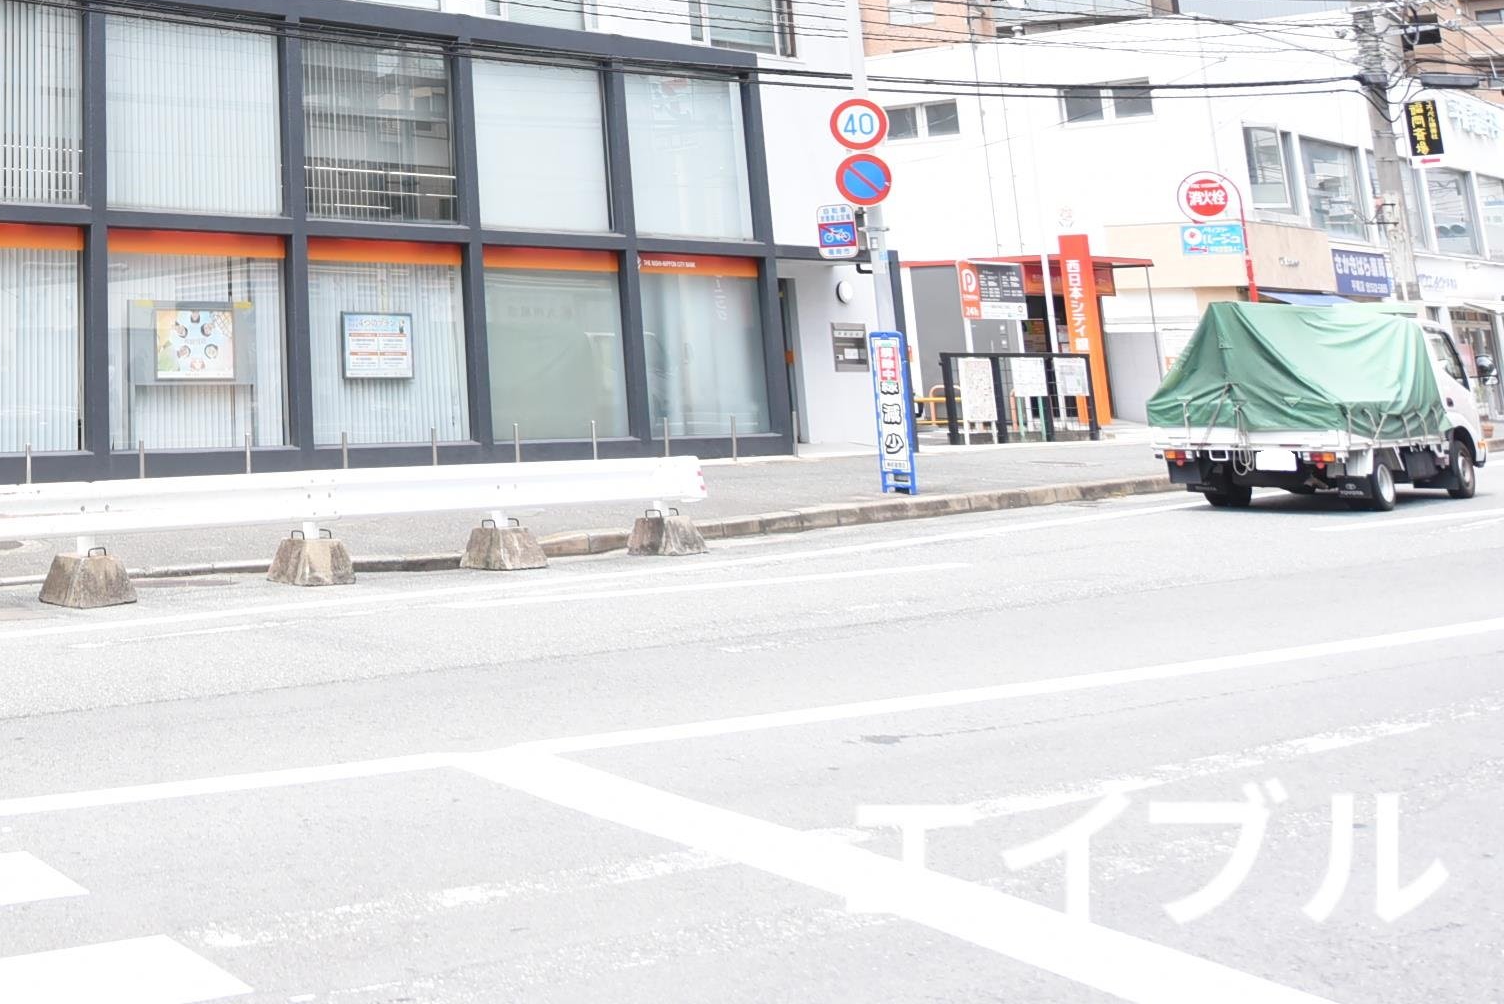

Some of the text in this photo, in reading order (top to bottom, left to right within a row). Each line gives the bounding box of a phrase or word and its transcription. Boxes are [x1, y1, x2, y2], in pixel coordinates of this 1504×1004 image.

[843, 112, 874, 136] 40
[1189, 189, 1226, 206] 消火栓
[1065, 259, 1090, 351] 西日本シティ銀
